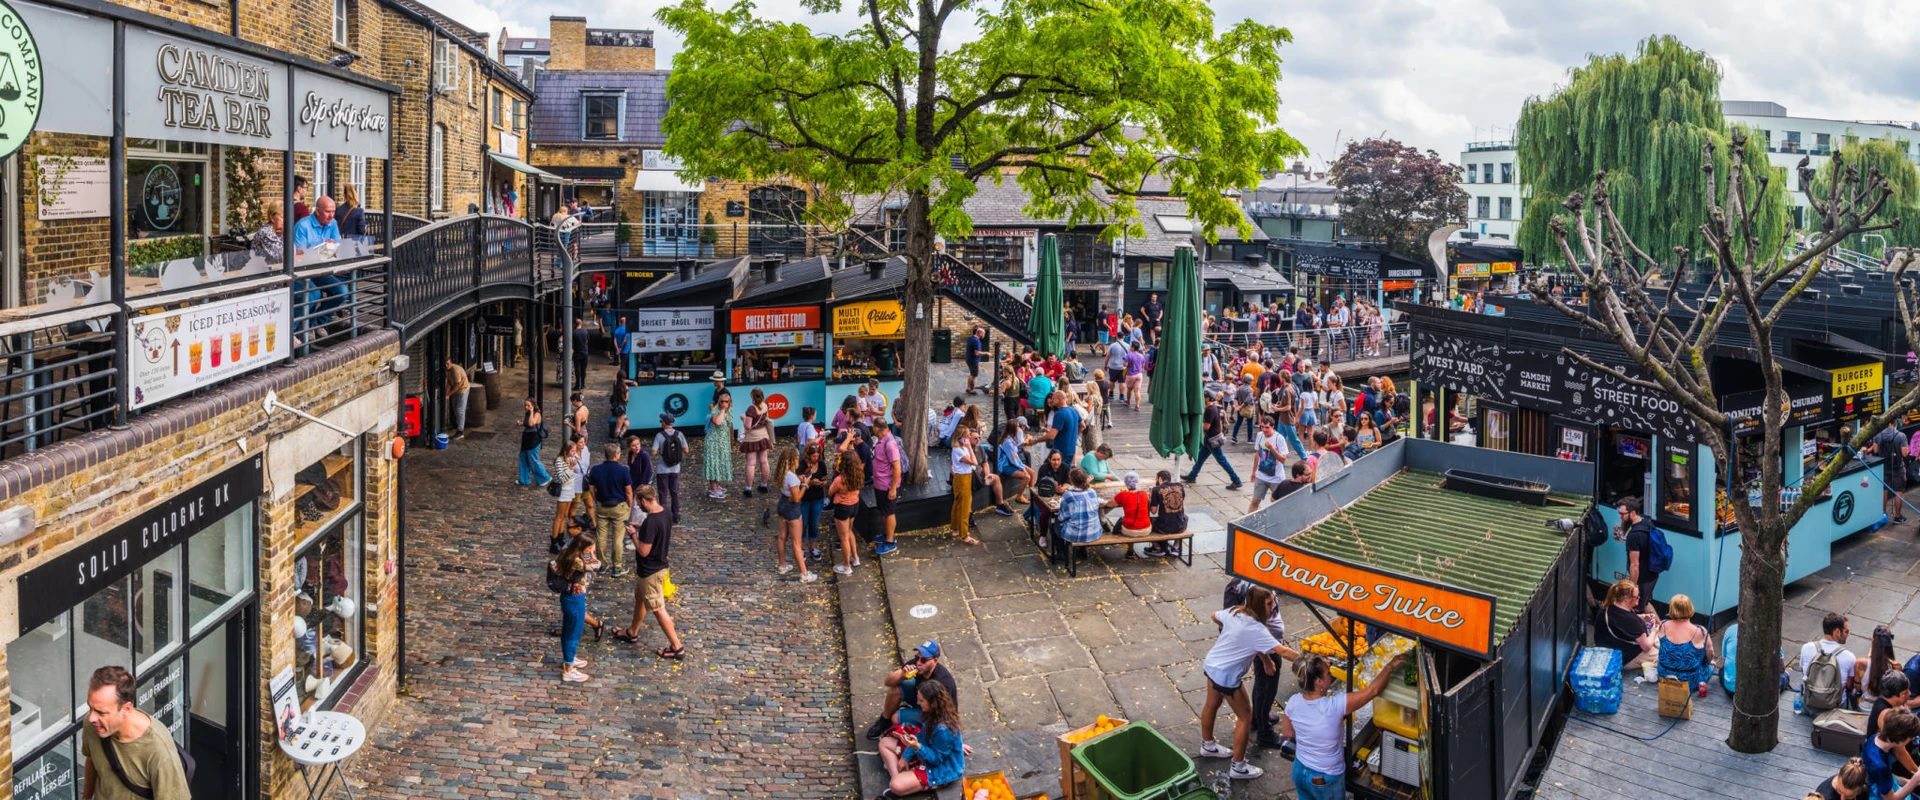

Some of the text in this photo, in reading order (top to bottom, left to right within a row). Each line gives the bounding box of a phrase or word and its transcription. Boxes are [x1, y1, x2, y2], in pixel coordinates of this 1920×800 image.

[1, 14, 38, 116] COMPANY
[156, 43, 270, 101] CAMDEN
[158, 85, 272, 138] TEA BAR
[189, 315, 214, 333] ICED
[215, 309, 234, 326] TEA
[236, 303, 270, 321] SEASON
[640, 317, 713, 327] BRISKET BAGEL FRIES
[745, 312, 807, 330] GREEK STREET FOOD
[838, 308, 860, 317] MULTI
[838, 317, 860, 325] AWARD
[1426, 354, 1485, 375] WEST YARD
[1520, 370, 1551, 383] CAMDEN
[1837, 368, 1873, 382] BURGERS
[1520, 379, 1551, 392] MARKET
[1837, 382, 1868, 395] & FRIES
[1593, 387, 1679, 413] STREET FOOD
[1791, 394, 1824, 408] CHURROS
[78, 483, 230, 585] SOLID COLOGNE UK
[1253, 548, 1466, 629] Orange Juice
[138, 667, 181, 706] SOLID FRAGRANCE
[13, 762, 51, 796] REFILLABLE
[57, 768, 71, 786] GIFT
